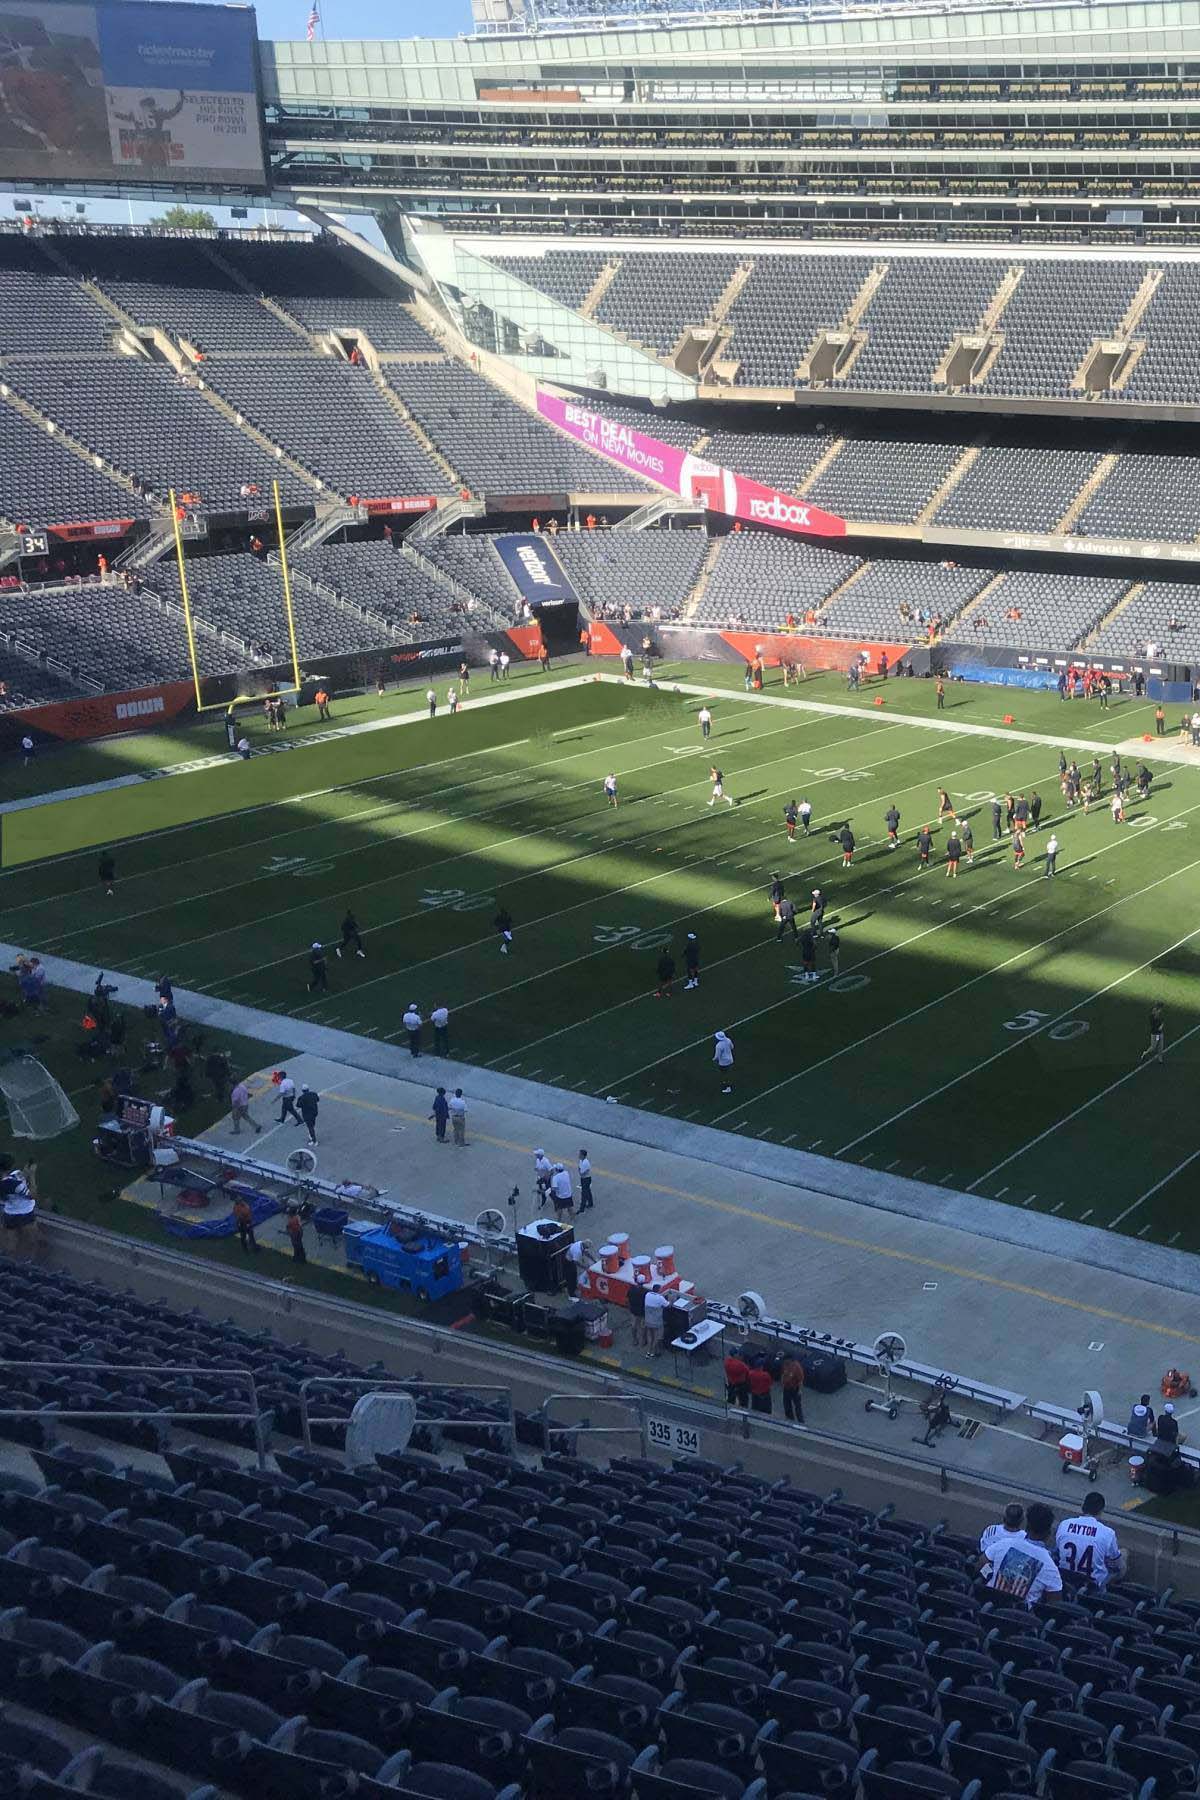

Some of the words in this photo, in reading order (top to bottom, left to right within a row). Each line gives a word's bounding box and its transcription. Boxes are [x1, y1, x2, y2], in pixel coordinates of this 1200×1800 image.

[565, 405, 598, 430] BEST
[601, 420, 635, 447] DEAL
[583, 429, 599, 443] ON
[601, 440, 625, 457] NEW
[627, 449, 664, 473] MOVIES
[749, 496, 810, 526] redbox
[25, 537, 45, 553] 34
[1077, 542, 1131, 555] Advocate
[516, 546, 552, 586] verizon
[116, 697, 163, 719] DOWN
[1002, 1009, 1091, 1041] 50
[649, 1420, 671, 1441] 335
[676, 1428, 698, 1449] 334
[1067, 1522, 1098, 1538] PAYTON
[1063, 1541, 1094, 1574] 34
